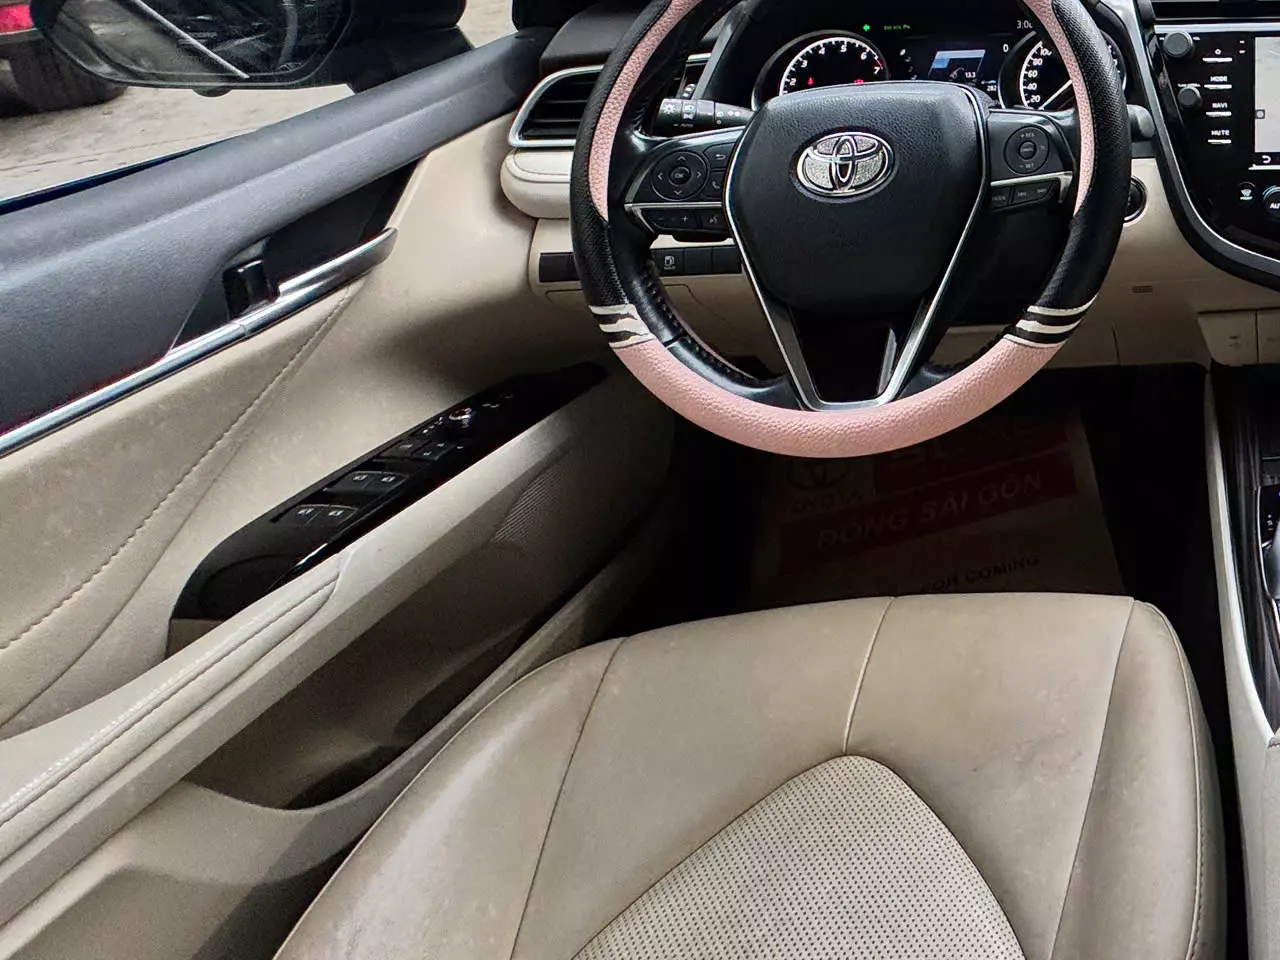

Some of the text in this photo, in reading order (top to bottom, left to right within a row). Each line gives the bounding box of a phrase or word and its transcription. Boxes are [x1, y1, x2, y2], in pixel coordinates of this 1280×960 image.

[818, 47, 825, 55] 4
[1003, 43, 1009, 53] 0
[860, 52, 867, 60] 6
[801, 60, 808, 68] 3
[1033, 58, 1043, 66] 80
[874, 67, 880, 75] 7
[1027, 70, 1038, 78] 60
[791, 78, 797, 86] 2
